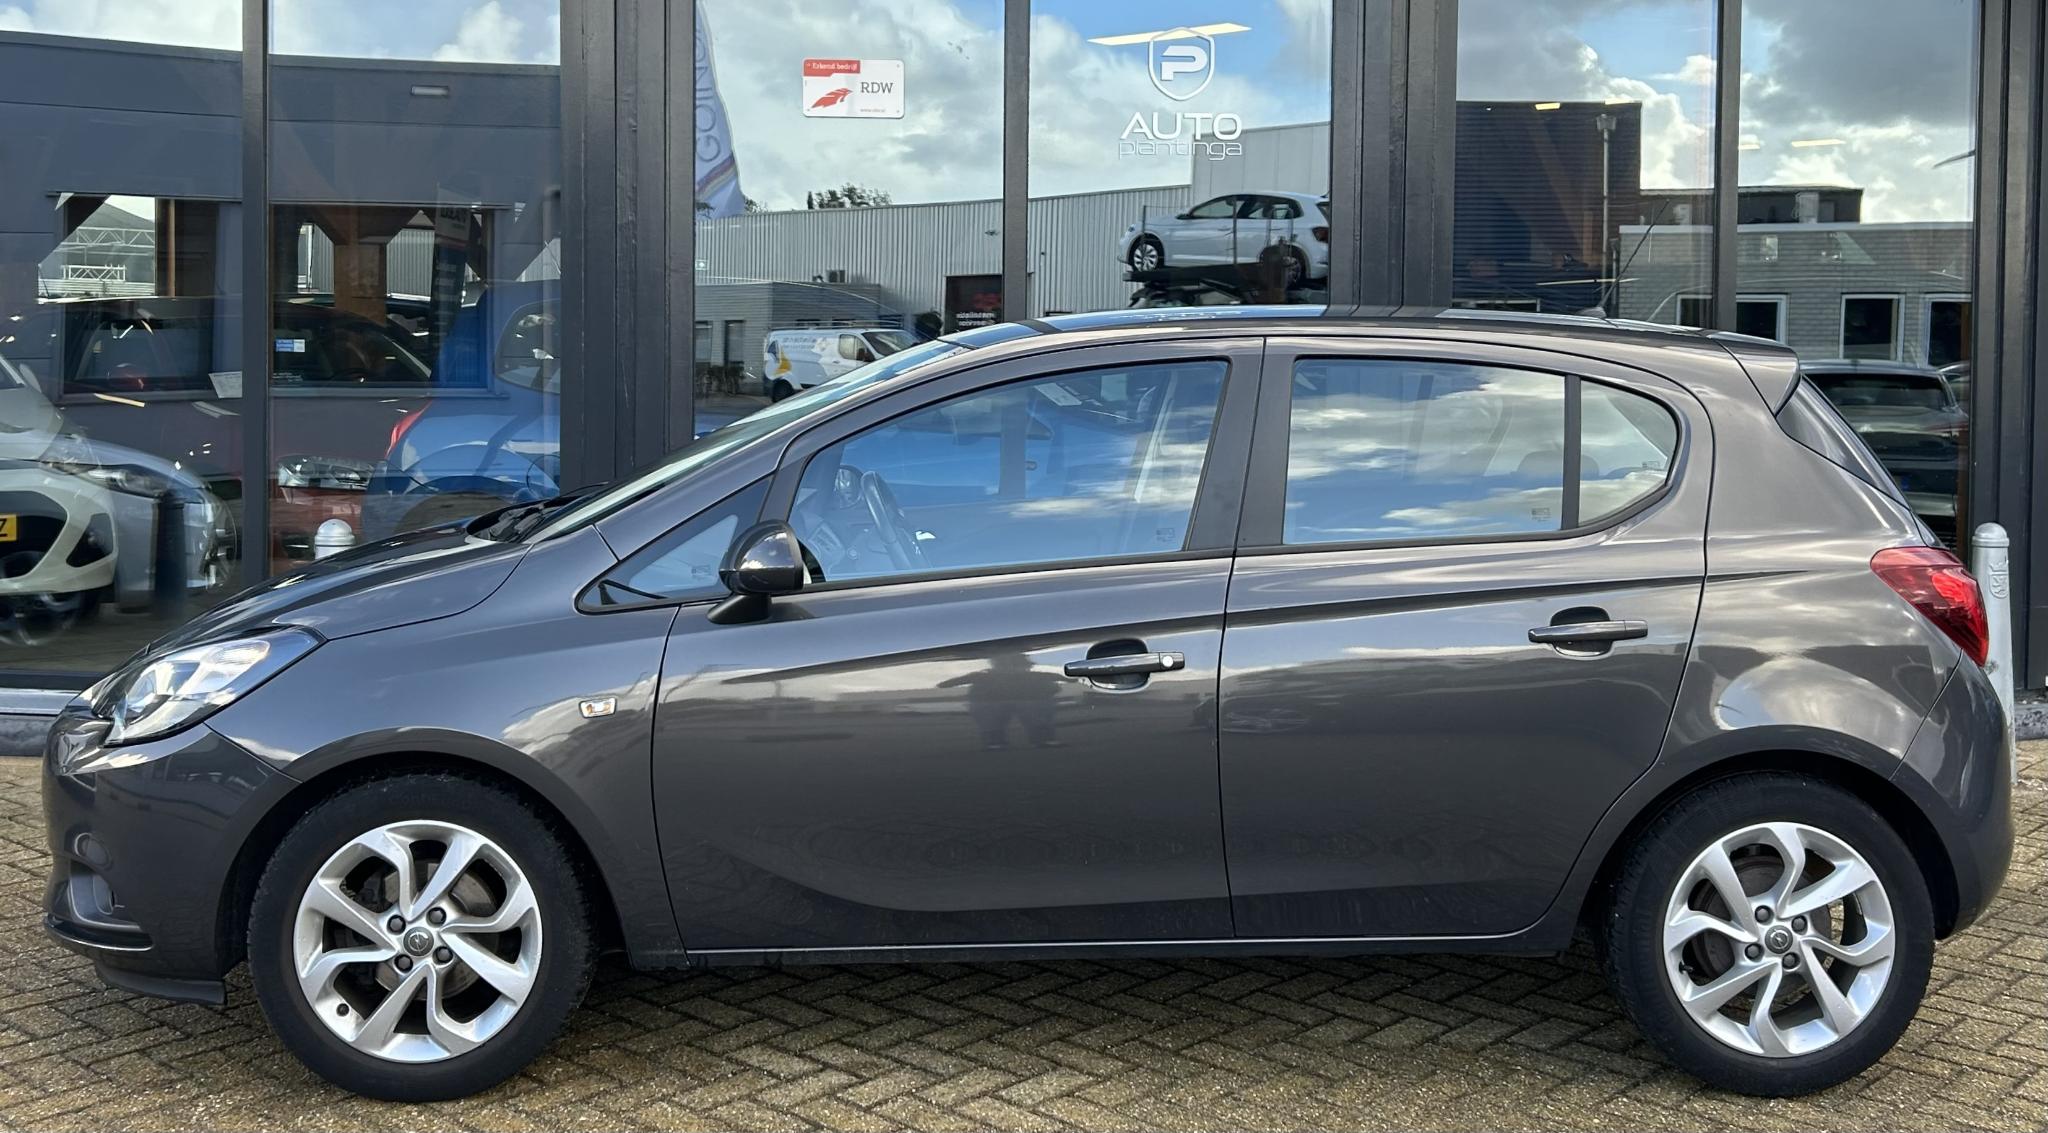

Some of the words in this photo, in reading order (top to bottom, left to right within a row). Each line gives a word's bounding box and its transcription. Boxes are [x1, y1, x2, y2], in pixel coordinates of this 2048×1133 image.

[1161, 45, 1208, 81] P
[860, 81, 894, 94] RDW
[1120, 112, 1243, 140] AUTO
[1119, 140, 1243, 161] plantinga
